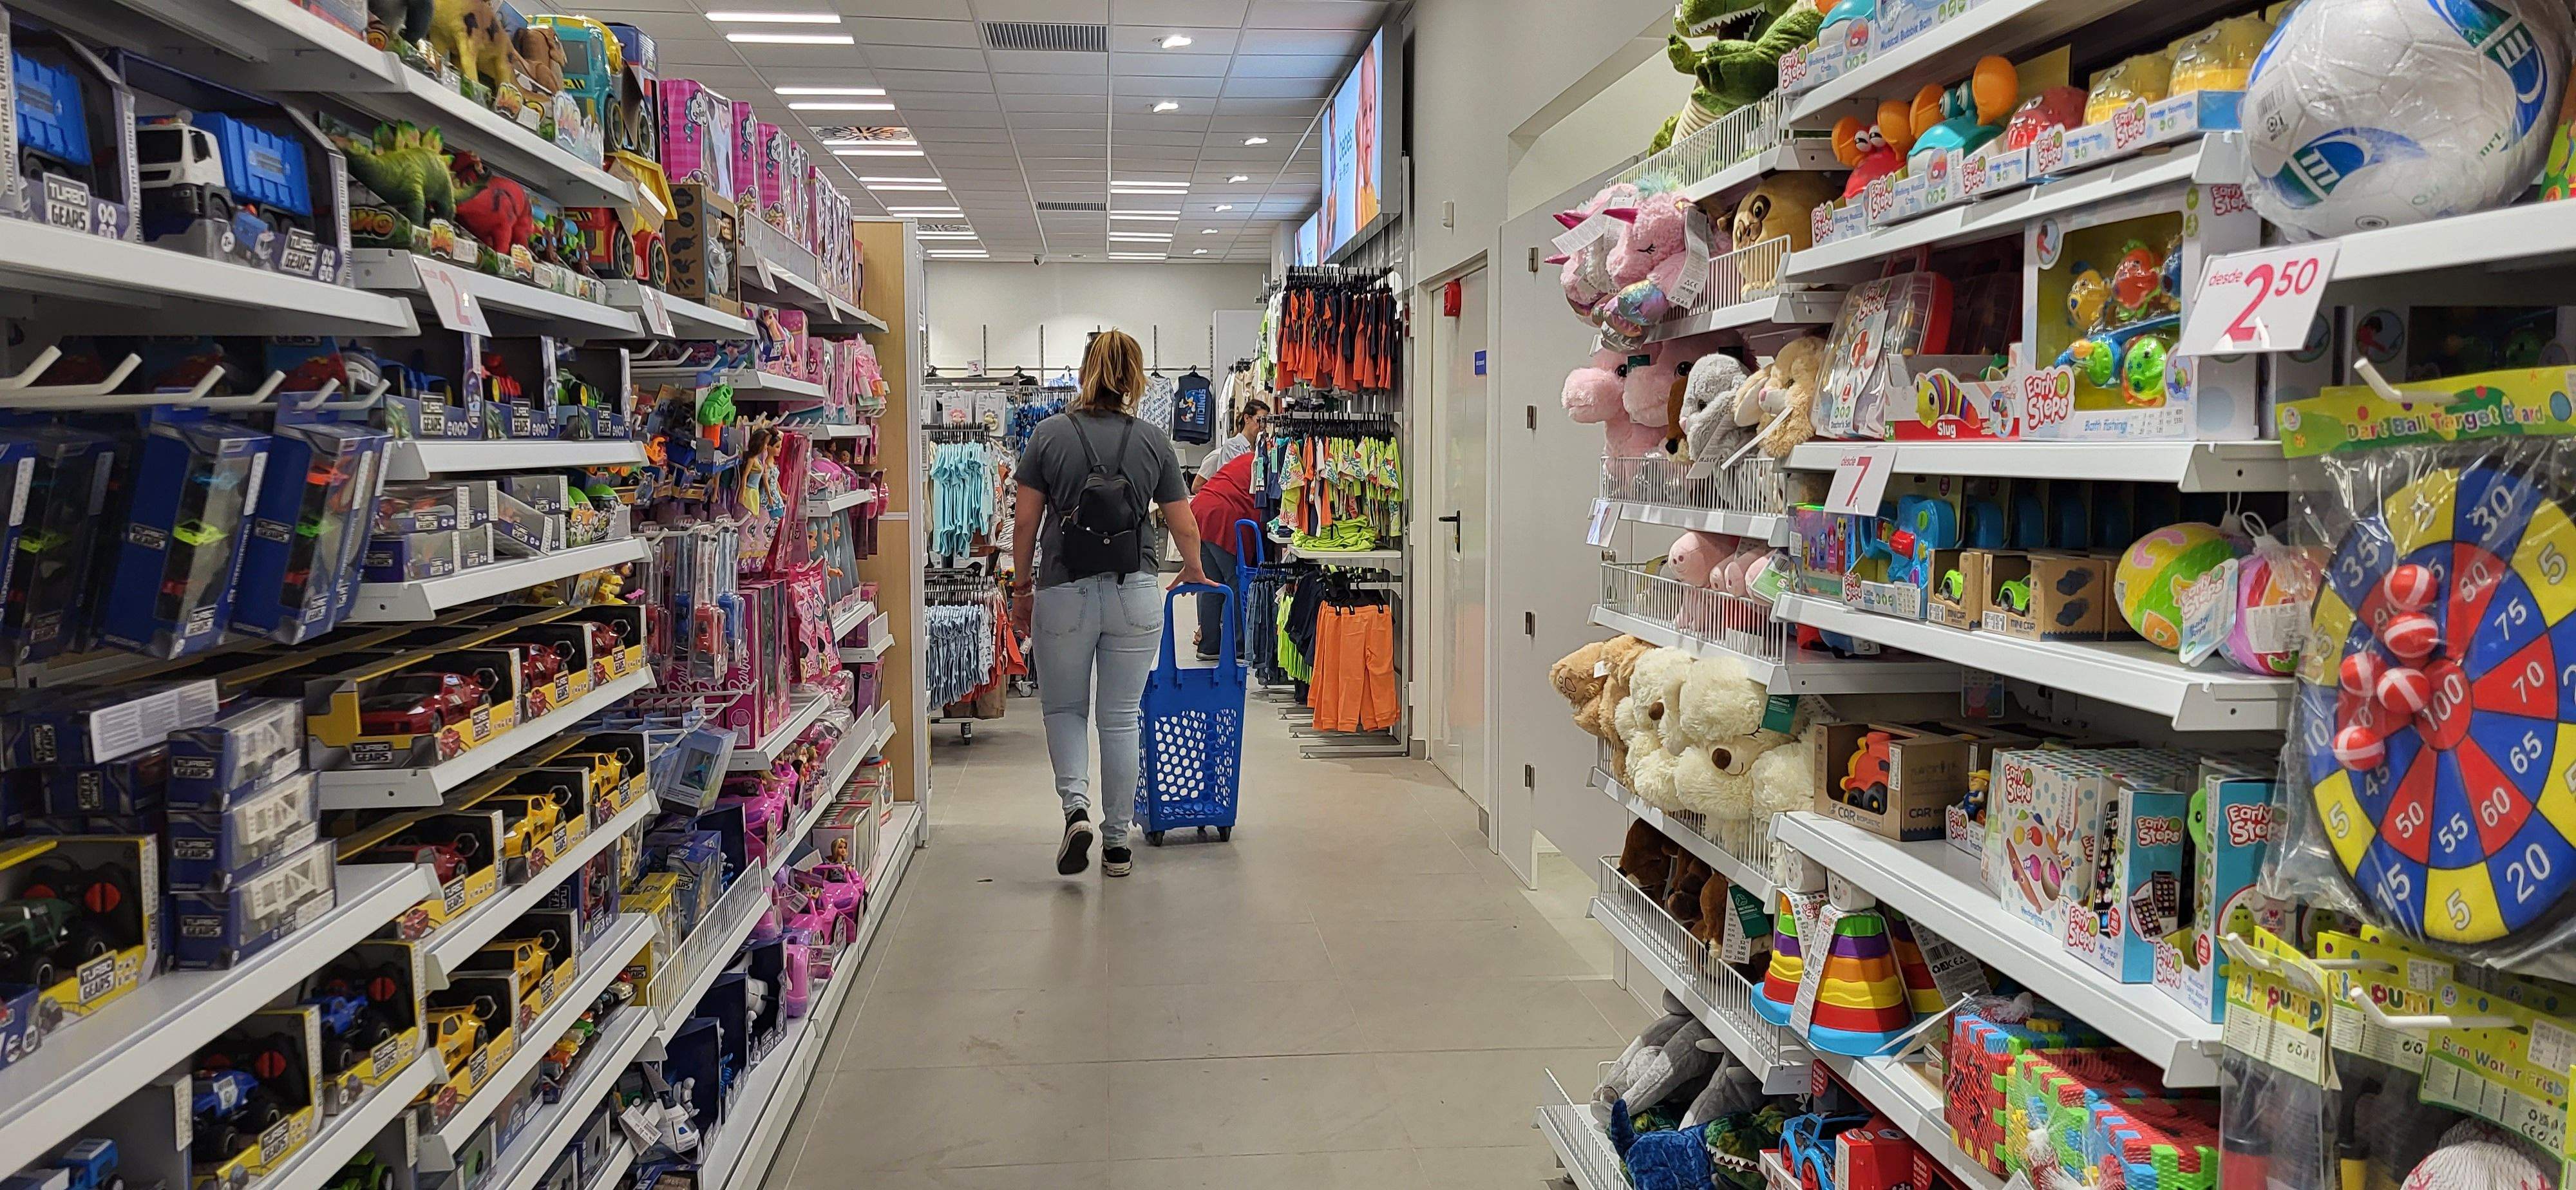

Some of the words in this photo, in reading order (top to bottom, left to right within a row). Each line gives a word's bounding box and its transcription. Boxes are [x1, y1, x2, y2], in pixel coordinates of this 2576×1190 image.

[1880, 35, 1899, 51] Musical
[1781, 50, 1798, 69] Early
[1781, 62, 1806, 89] Steps
[2114, 111, 2136, 128] Early
[2036, 136, 2054, 153] Early
[2116, 122, 2146, 149] Steps
[1963, 162, 1978, 176] Early
[2038, 148, 2062, 172] Steps
[48, 183, 87, 206] TURBO
[1870, 181, 1886, 196] Early
[1964, 171, 1986, 194] Steps
[52, 204, 86, 229] GEARS
[1812, 209, 1826, 222] Early
[1871, 192, 1894, 219] Steps
[1814, 218, 1834, 243] Steps
[2209, 268, 2243, 287] desde
[2274, 257, 2318, 297] 50
[2221, 263, 2275, 343] 2
[972, 363, 979, 372] 3
[2025, 373, 2057, 399] Early
[2028, 397, 2069, 431] Steps
[2085, 419, 2101, 432] Bath
[2347, 422, 2389, 442] Dart
[2391, 415, 2429, 437] Ball
[2430, 405, 2501, 433] Target
[2502, 404, 2544, 424] Board
[1937, 422, 1956, 439] Slug
[1841, 456, 1856, 467] desde
[1845, 456, 1872, 507] 7
[2469, 485, 2514, 542] 30
[2341, 533, 2380, 589] 35
[2427, 556, 2446, 583] 5
[2537, 542, 2570, 585] 5
[2459, 561, 2490, 603] 80
[2182, 580, 2224, 619] Steps
[2010, 618, 2023, 628] MINI
[2023, 619, 2036, 632] CAR
[2494, 596, 2528, 641] 75
[2512, 661, 2545, 704] 70
[2421, 672, 2465, 733] 100
[2304, 718, 2330, 757] 10
[2510, 730, 2543, 775] 65
[2005, 764, 2025, 784] Early
[2006, 780, 2032, 804] Steps
[1837, 806, 1856, 824] CAR
[1908, 807, 1931, 819] CAR
[1948, 809, 1962, 826] Early
[2228, 804, 2273, 824] Early
[2480, 786, 2512, 827] 60
[1949, 822, 1968, 840] Steps
[2137, 816, 2169, 831] Early
[2329, 800, 2351, 839] 5
[2395, 800, 2425, 839] 50
[2139, 829, 2181, 846] Steps
[2231, 821, 2288, 846] Steps
[2438, 811, 2469, 854] 55
[2506, 842, 2552, 905] 20
[2376, 862, 2411, 912] 15
[1802, 902, 1821, 911] Early
[2070, 905, 2089, 932] Early
[2446, 889, 2472, 930] 5
[2067, 923, 2096, 954] Steps
[2099, 942, 2106, 954] My
[2106, 945, 2119, 958] First
[2099, 952, 2116, 968] Phone
[2156, 943, 2174, 968] Early
[2156, 959, 2182, 990] Steps
[2232, 972, 2261, 1006] Air
